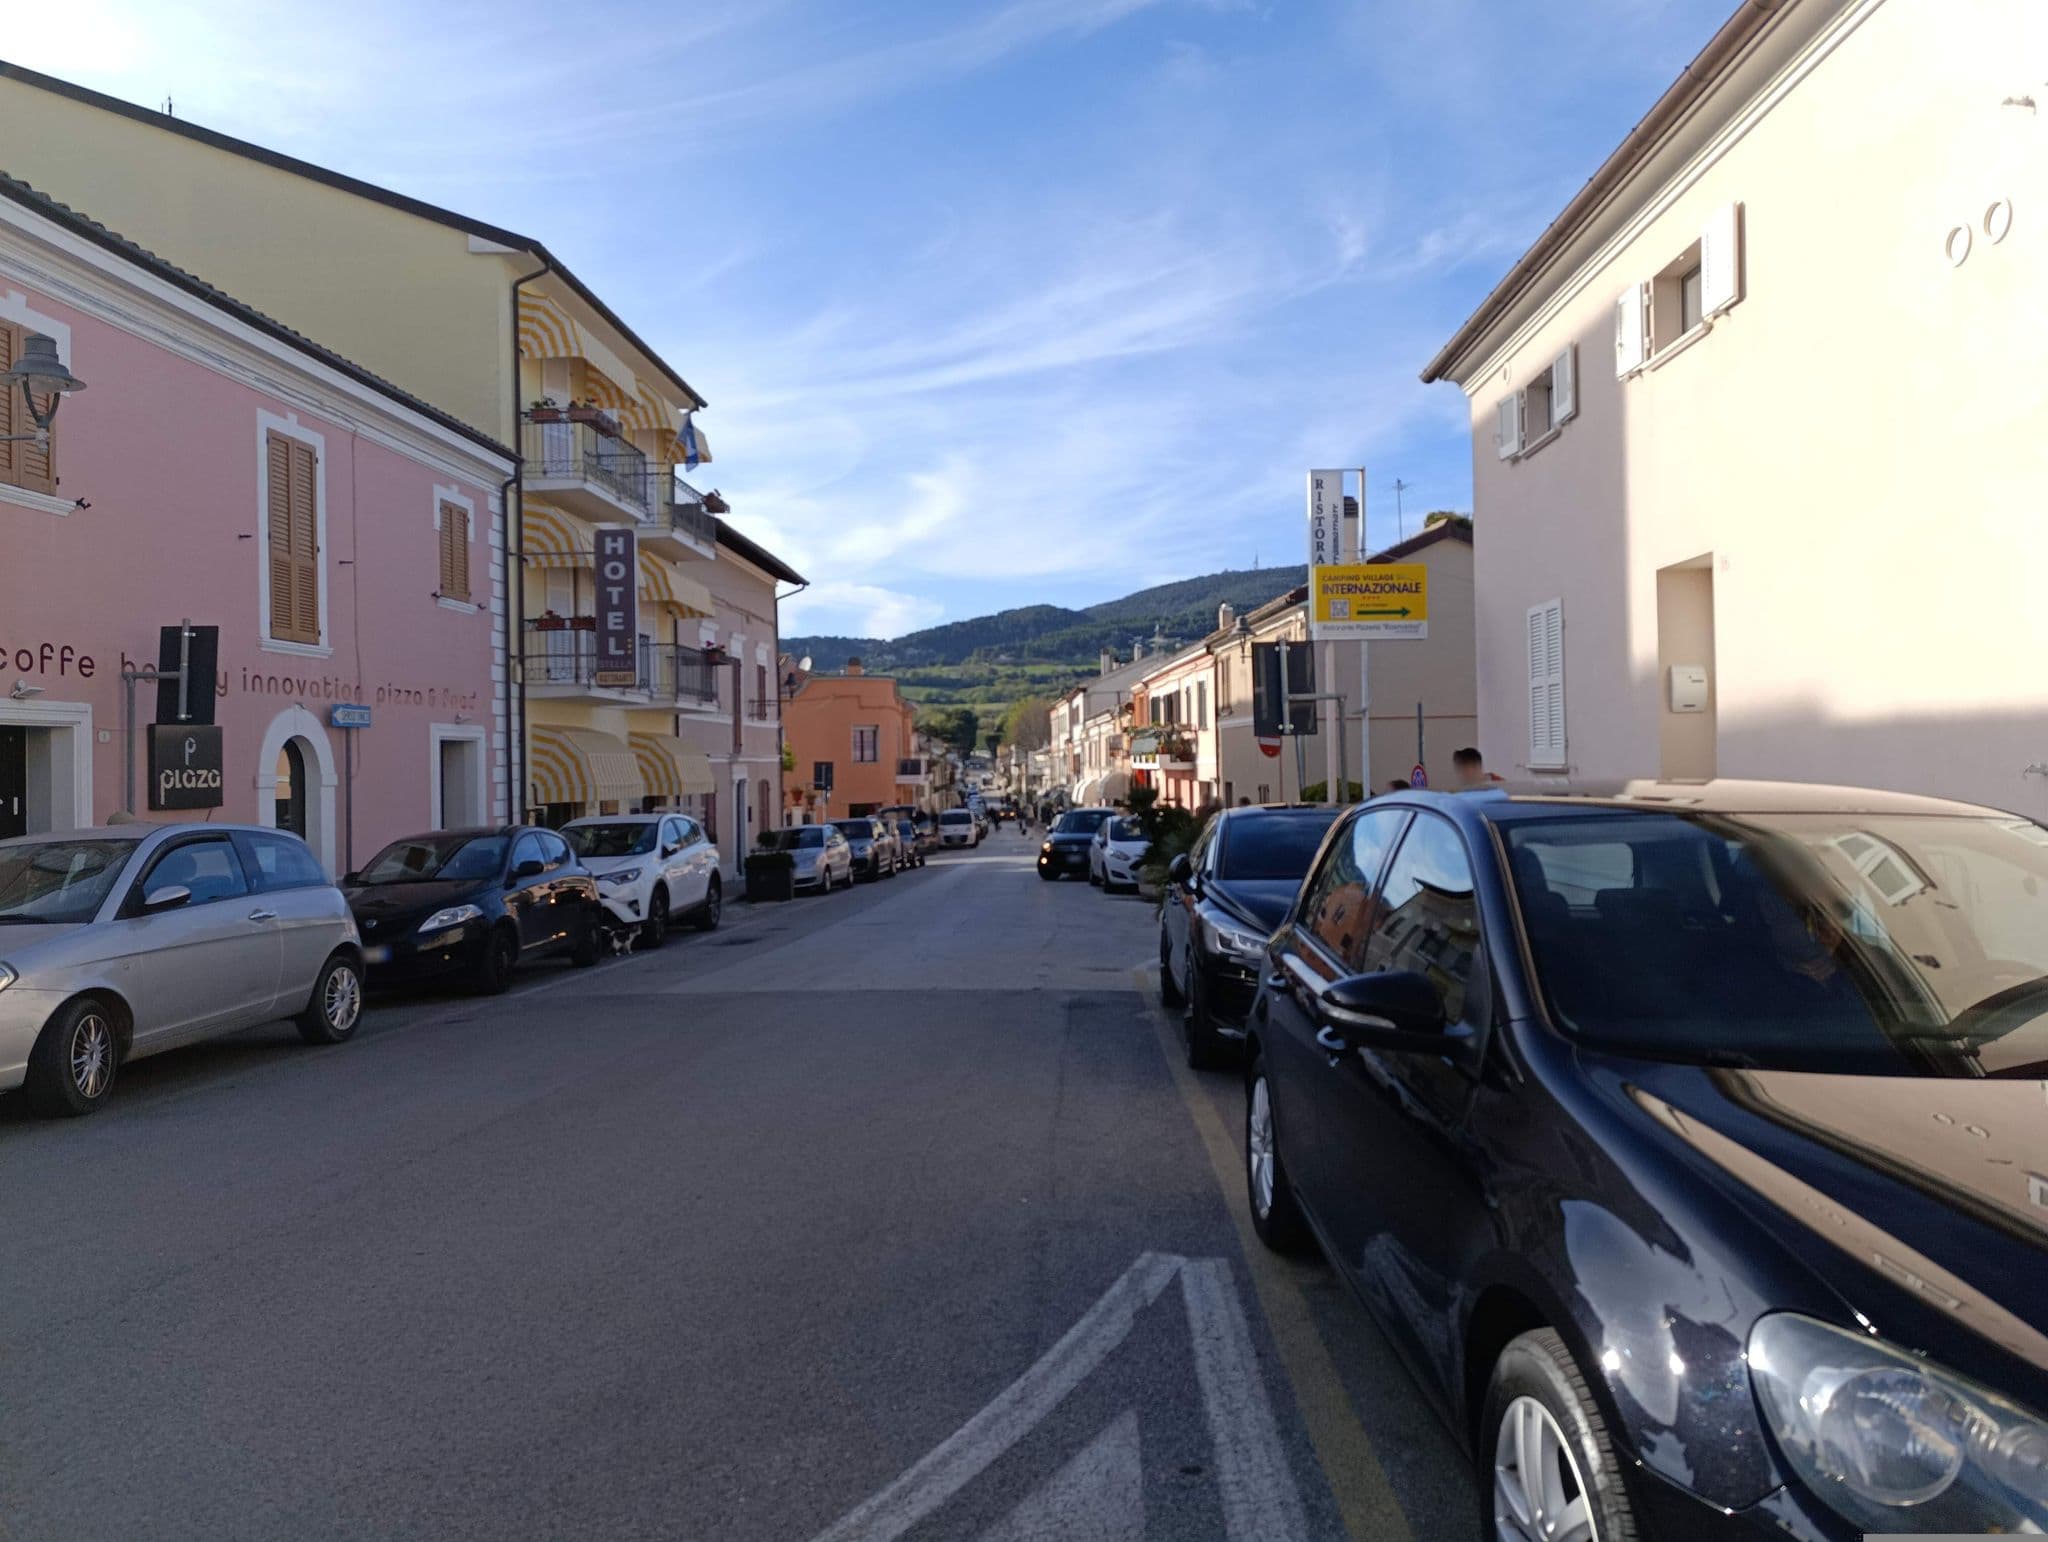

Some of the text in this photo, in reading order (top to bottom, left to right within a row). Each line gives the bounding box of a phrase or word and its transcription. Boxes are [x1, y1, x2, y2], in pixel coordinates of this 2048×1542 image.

[603, 536, 626, 656] HOTEL
[1322, 582, 1421, 595] INTERNAZIONALE
[160, 769, 221, 805] plaza
